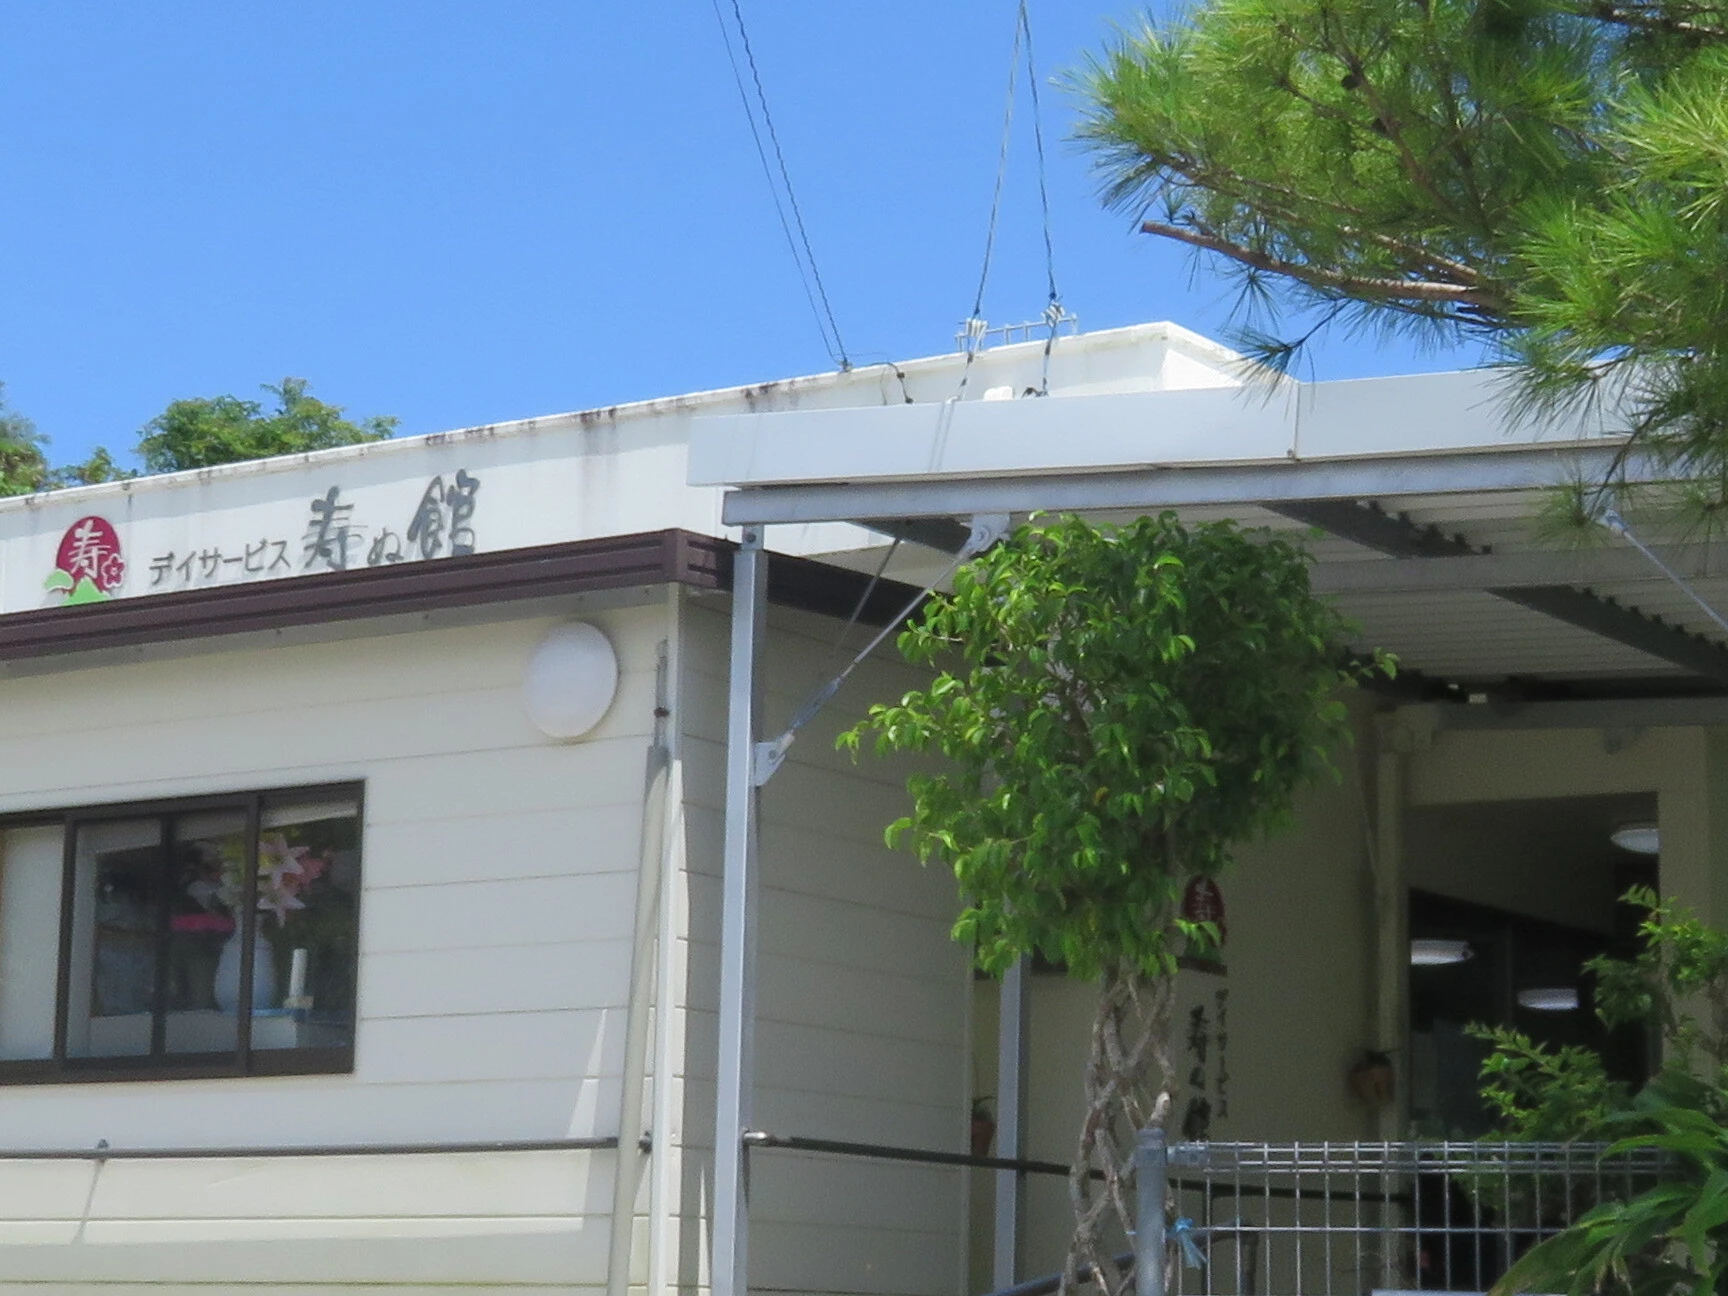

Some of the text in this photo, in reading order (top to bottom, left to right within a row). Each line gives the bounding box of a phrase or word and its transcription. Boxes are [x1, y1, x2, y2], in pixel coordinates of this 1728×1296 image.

[67, 519, 112, 577] 寿
[149, 539, 292, 586] デイサービス
